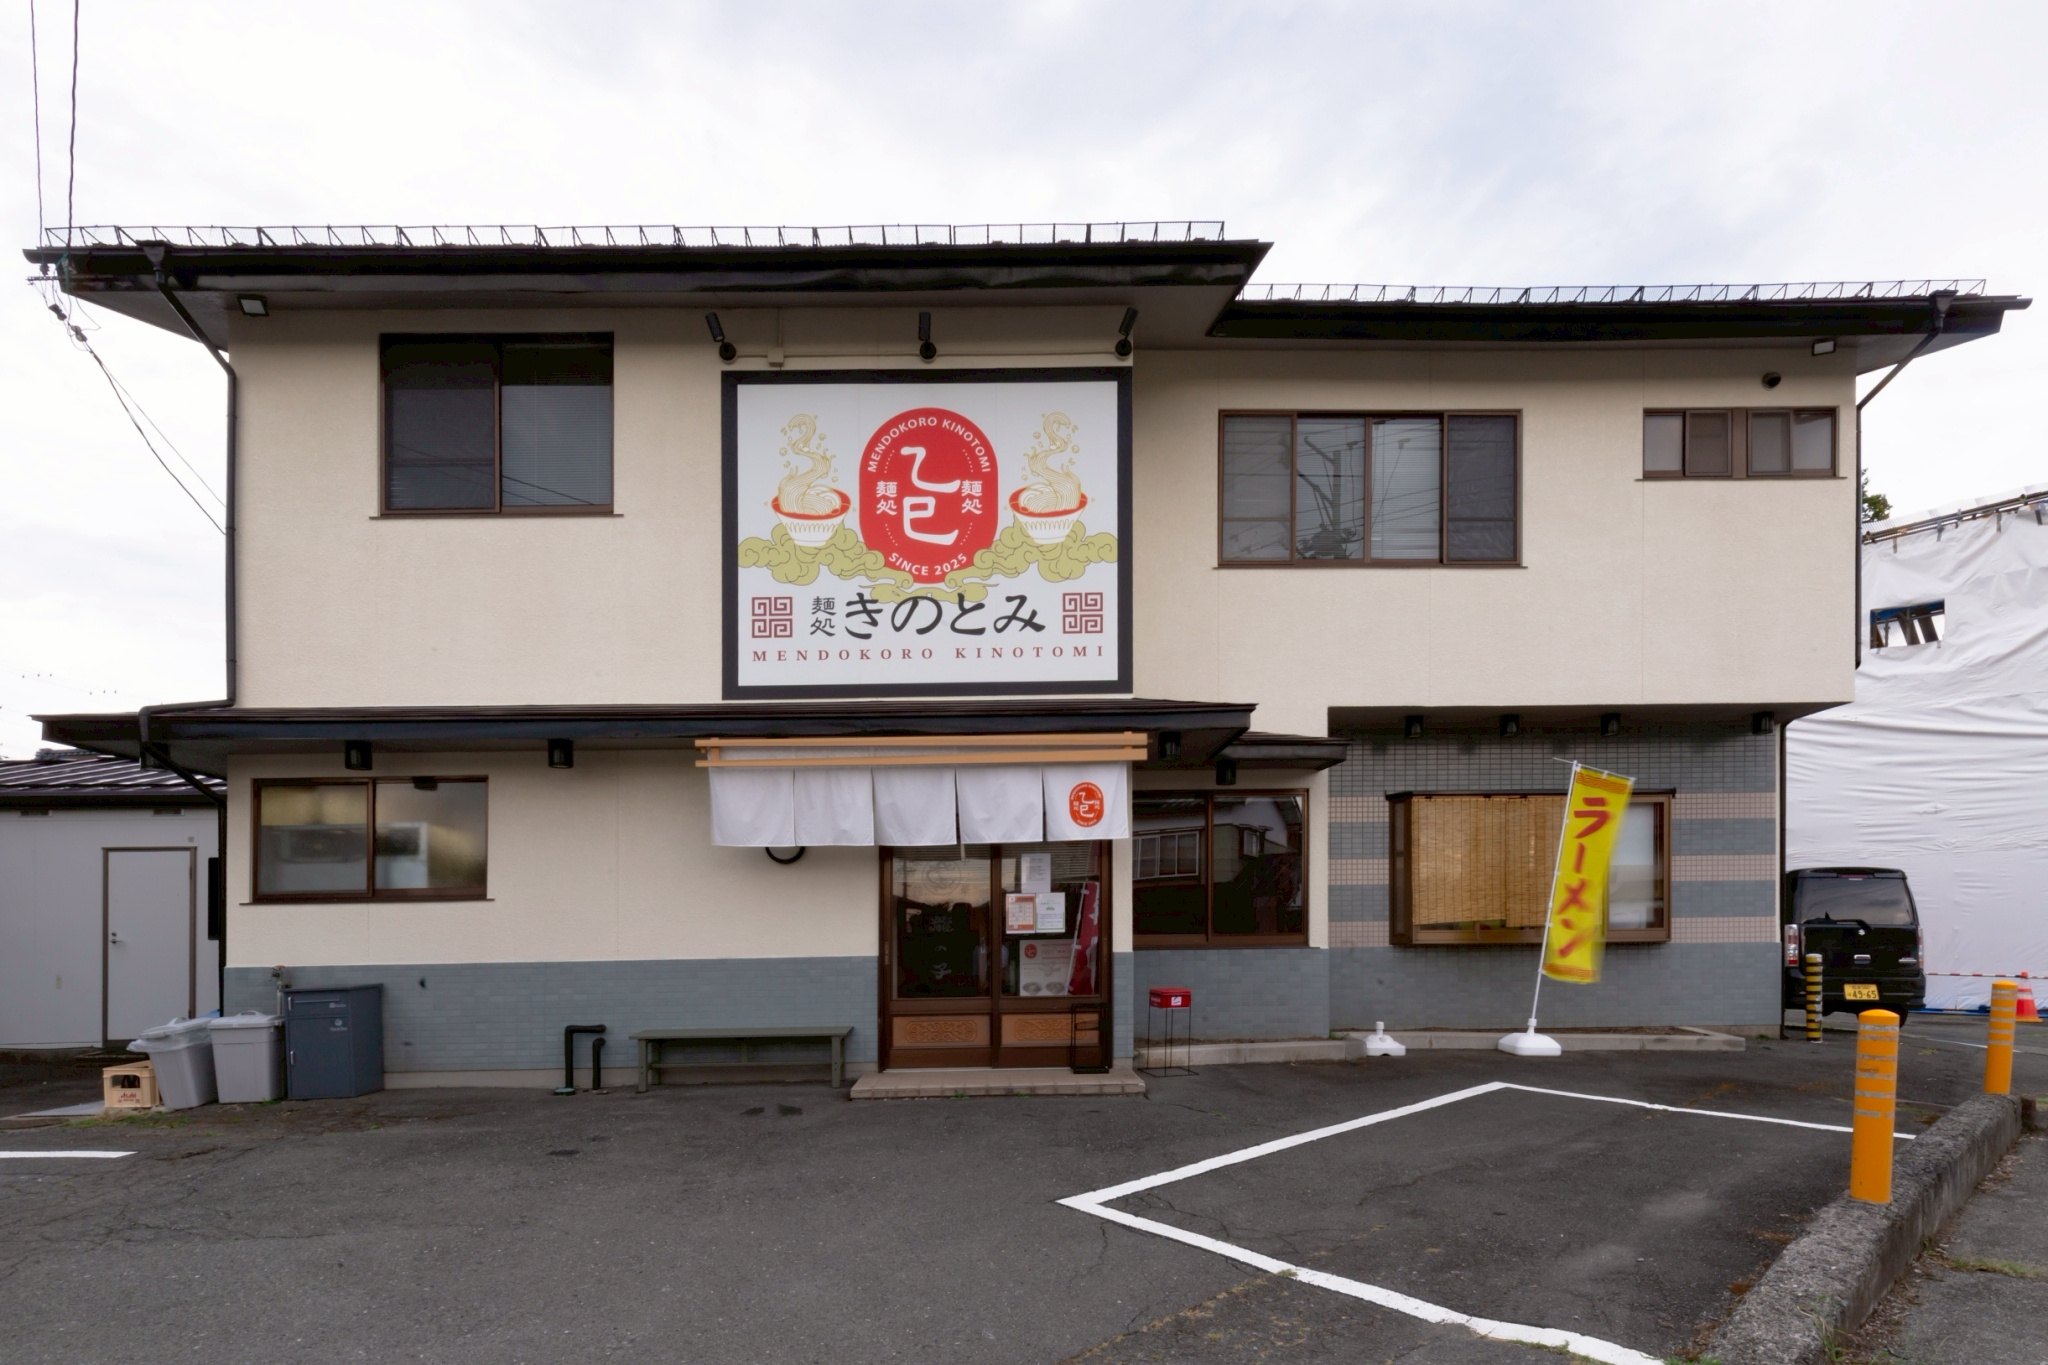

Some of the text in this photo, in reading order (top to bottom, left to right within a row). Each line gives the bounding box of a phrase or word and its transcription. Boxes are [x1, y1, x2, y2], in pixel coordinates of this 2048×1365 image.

[867, 416, 992, 473] MENDOKORO KINOTOMI
[876, 480, 898, 516] 麺処
[900, 446, 961, 546] 乙巳
[961, 479, 983, 515] 麺処
[888, 551, 968, 576] SINCE 2025
[844, 592, 1047, 640] きのとみ
[752, 645, 1104, 662] MENDOKORO KINOTOMI
[1556, 796, 1612, 959] ラーメン
